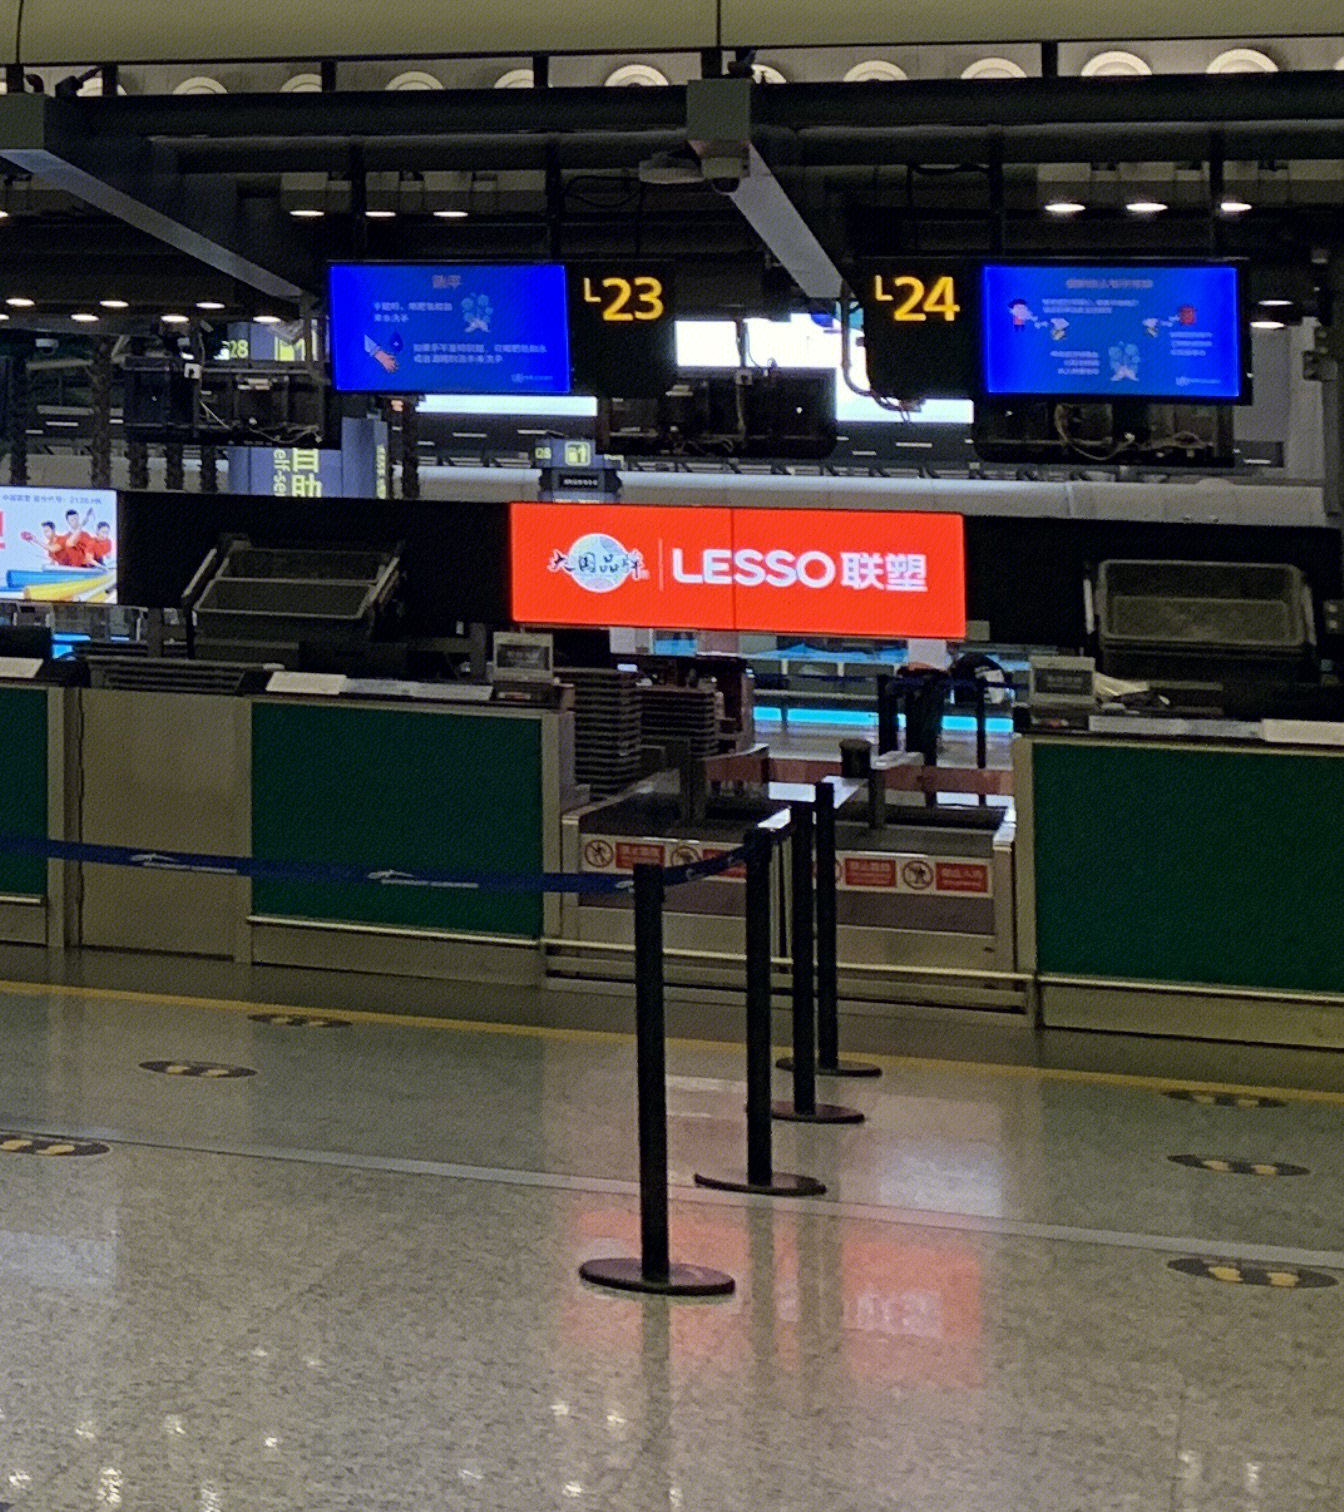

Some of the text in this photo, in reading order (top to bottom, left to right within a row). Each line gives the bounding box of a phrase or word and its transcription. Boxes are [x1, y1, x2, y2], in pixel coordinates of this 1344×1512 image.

[584, 276, 664, 321] L23
[875, 275, 961, 322] L24
[672, 548, 928, 592] LESSO 联塑
